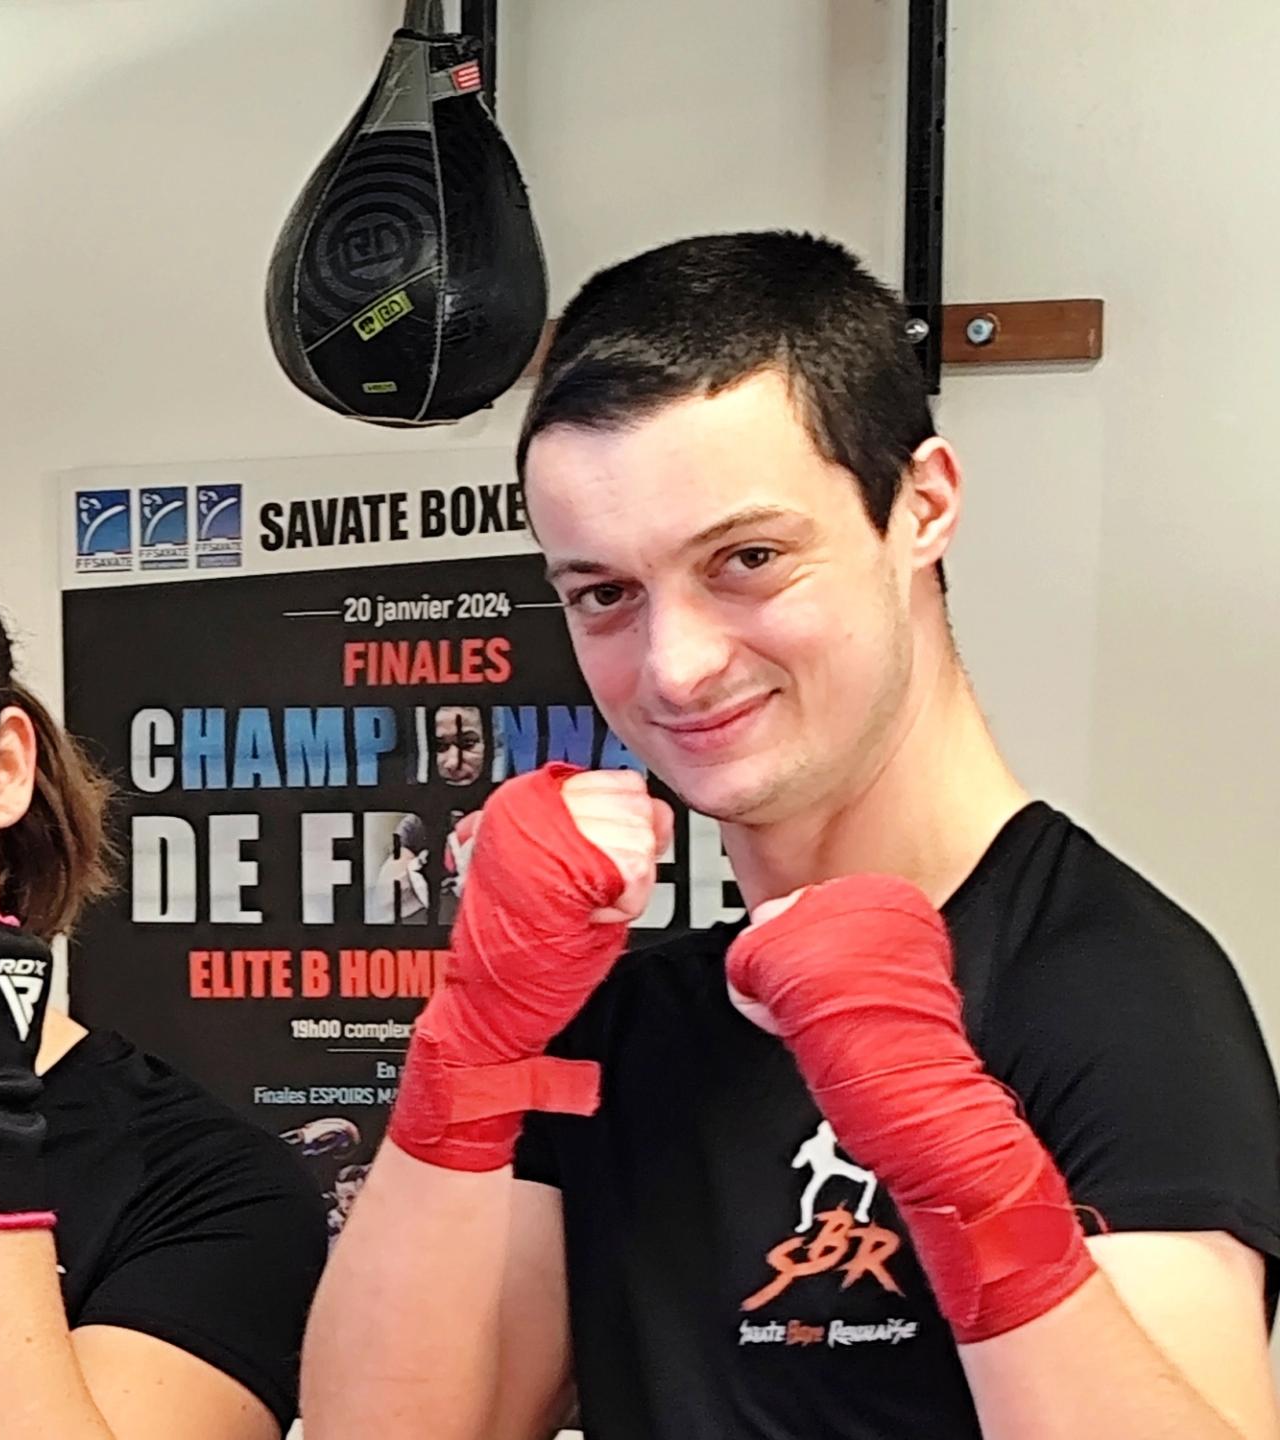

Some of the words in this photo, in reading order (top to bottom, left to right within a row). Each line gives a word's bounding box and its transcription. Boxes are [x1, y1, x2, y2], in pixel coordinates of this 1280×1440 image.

[260, 493, 408, 551] SAVATE
[419, 482, 526, 538] BOXE
[344, 597, 371, 622] 20
[374, 595, 453, 628] janvier
[457, 593, 510, 620] 2024
[343, 637, 512, 687] FINALES
[130, 704, 648, 792] CHAMPIONNA
[131, 812, 263, 925] DE
[189, 950, 293, 998] ELITE
[301, 950, 330, 998] B
[291, 1020, 341, 1038] 19h00
[344, 1020, 413, 1042] complex
[376, 1062, 397, 1079] En
[254, 1086, 306, 1104] Finales
[309, 1087, 375, 1104] ESPOIRS
